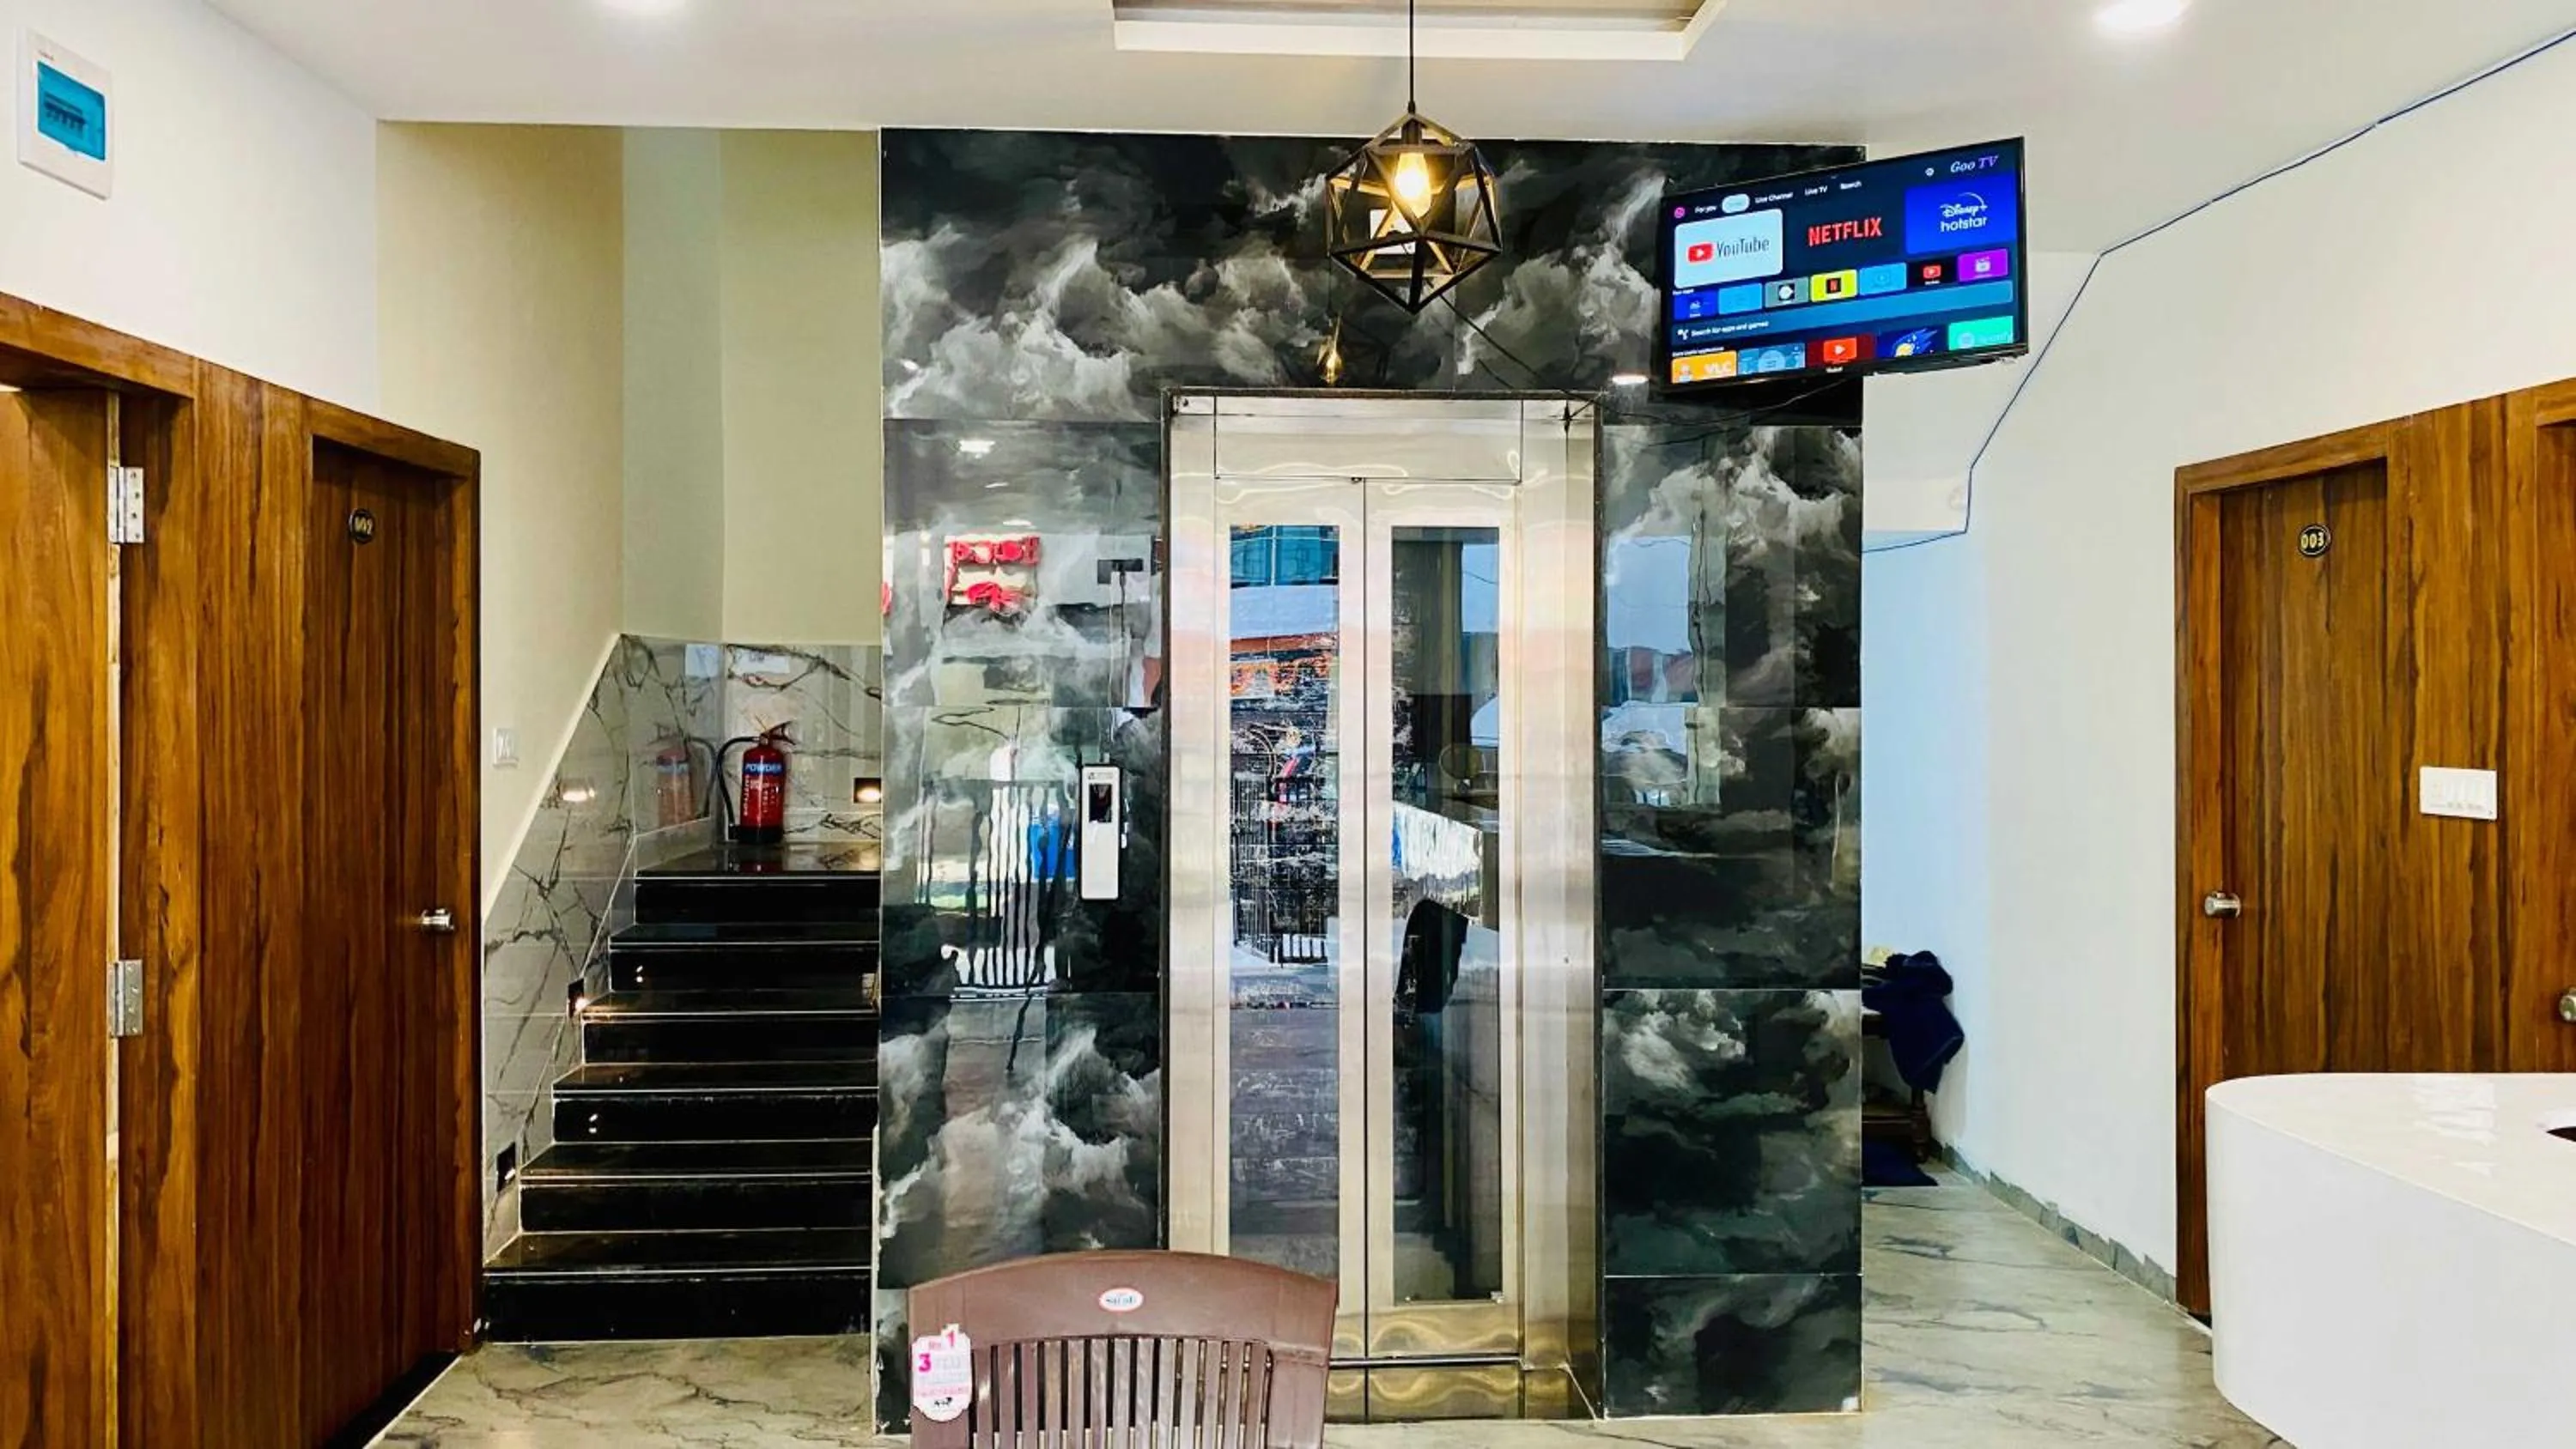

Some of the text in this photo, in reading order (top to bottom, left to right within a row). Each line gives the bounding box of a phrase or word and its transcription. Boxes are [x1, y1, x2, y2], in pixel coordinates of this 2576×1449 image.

[1949, 155, 1999, 173] Goo TV
[1807, 216, 1882, 247] NETFLIX
[1940, 216, 1988, 233] hotstar
[1716, 237, 1771, 258] YouTube
[2300, 531, 2324, 549] 003
[918, 1352, 932, 1373] 3
